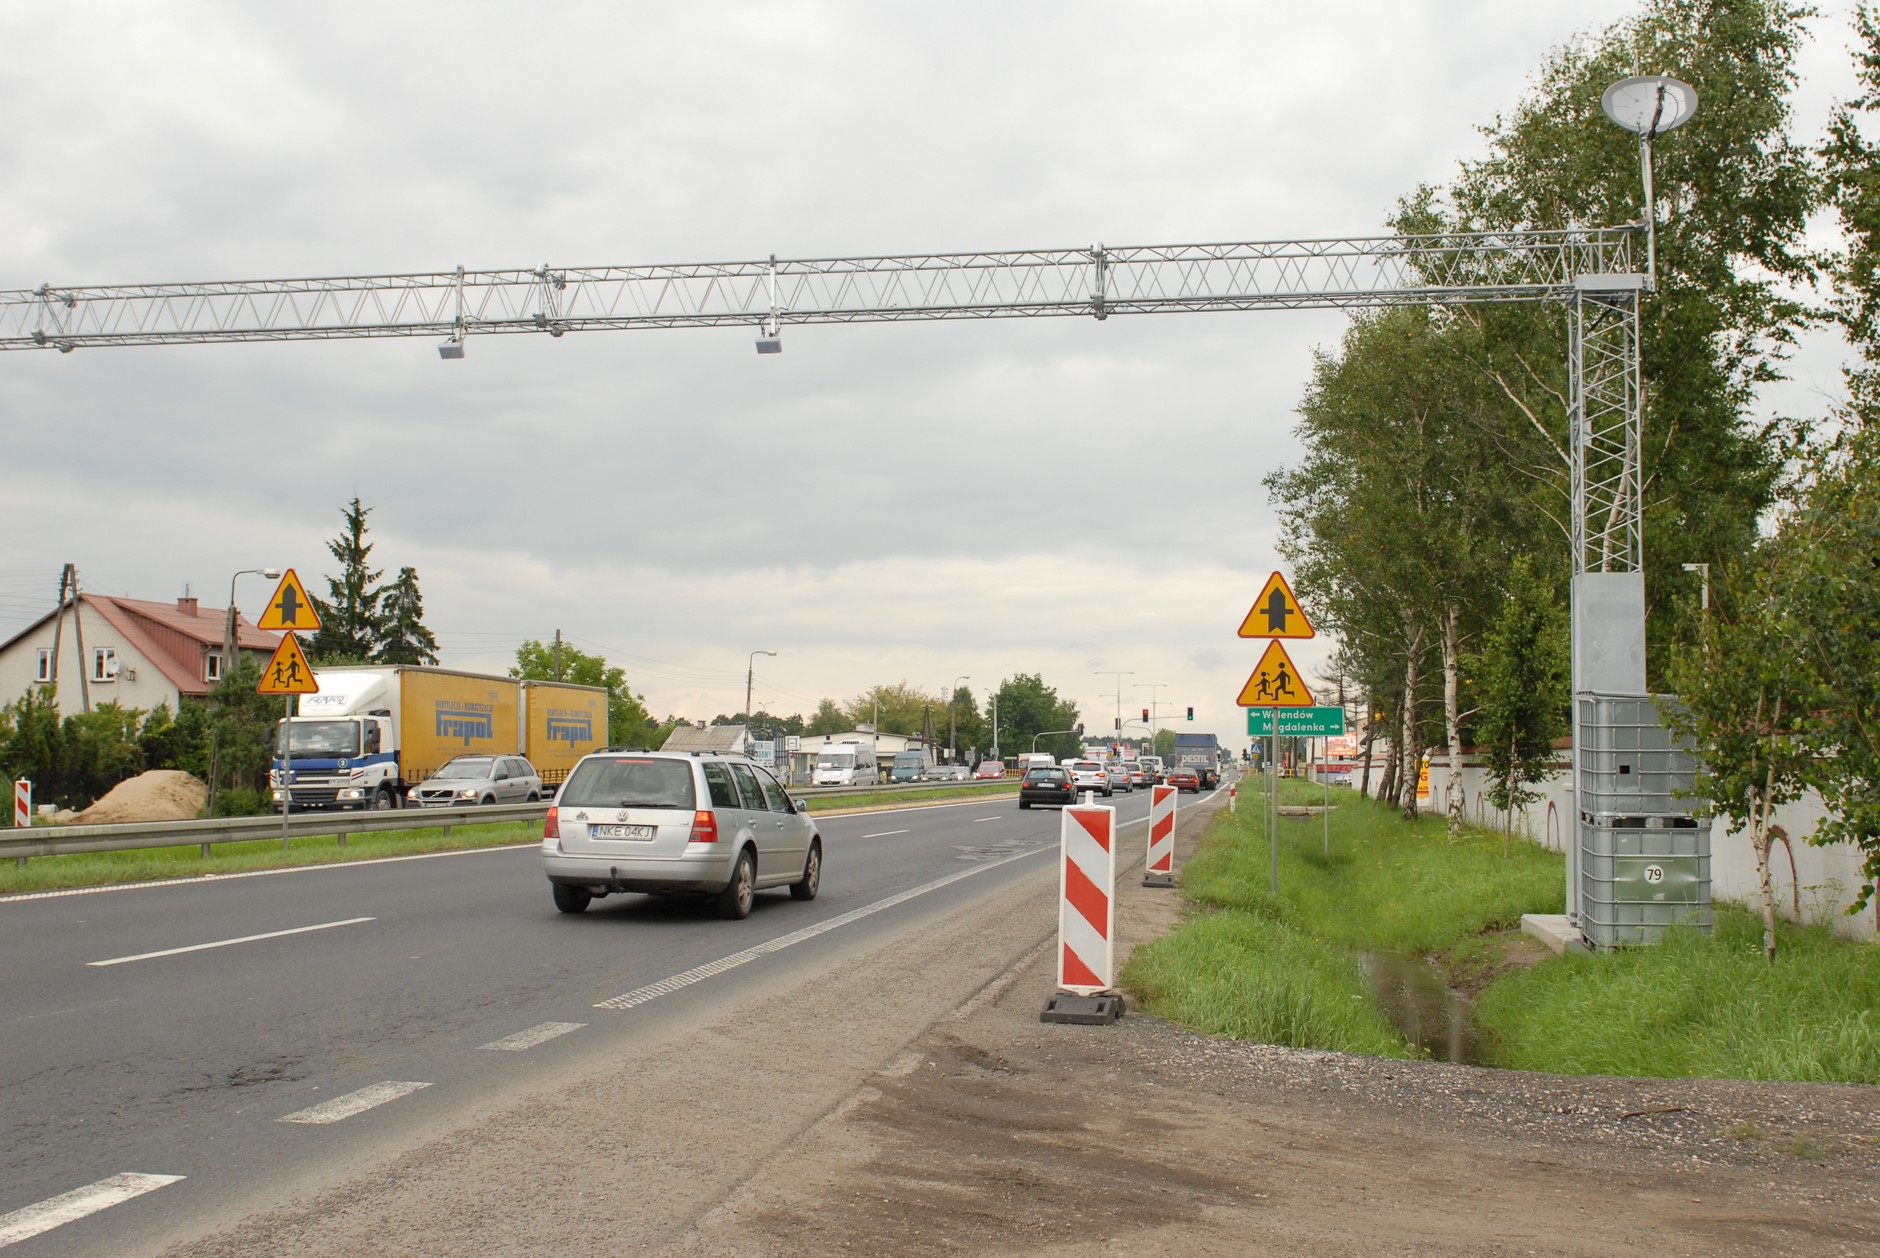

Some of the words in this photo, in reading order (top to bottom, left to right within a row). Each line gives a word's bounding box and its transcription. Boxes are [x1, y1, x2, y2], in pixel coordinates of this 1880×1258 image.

[1181, 754, 1209, 763] DESTIL
[599, 825, 622, 837] NKE
[624, 827, 650, 838] 04KJ
[1646, 868, 1662, 881] 79
